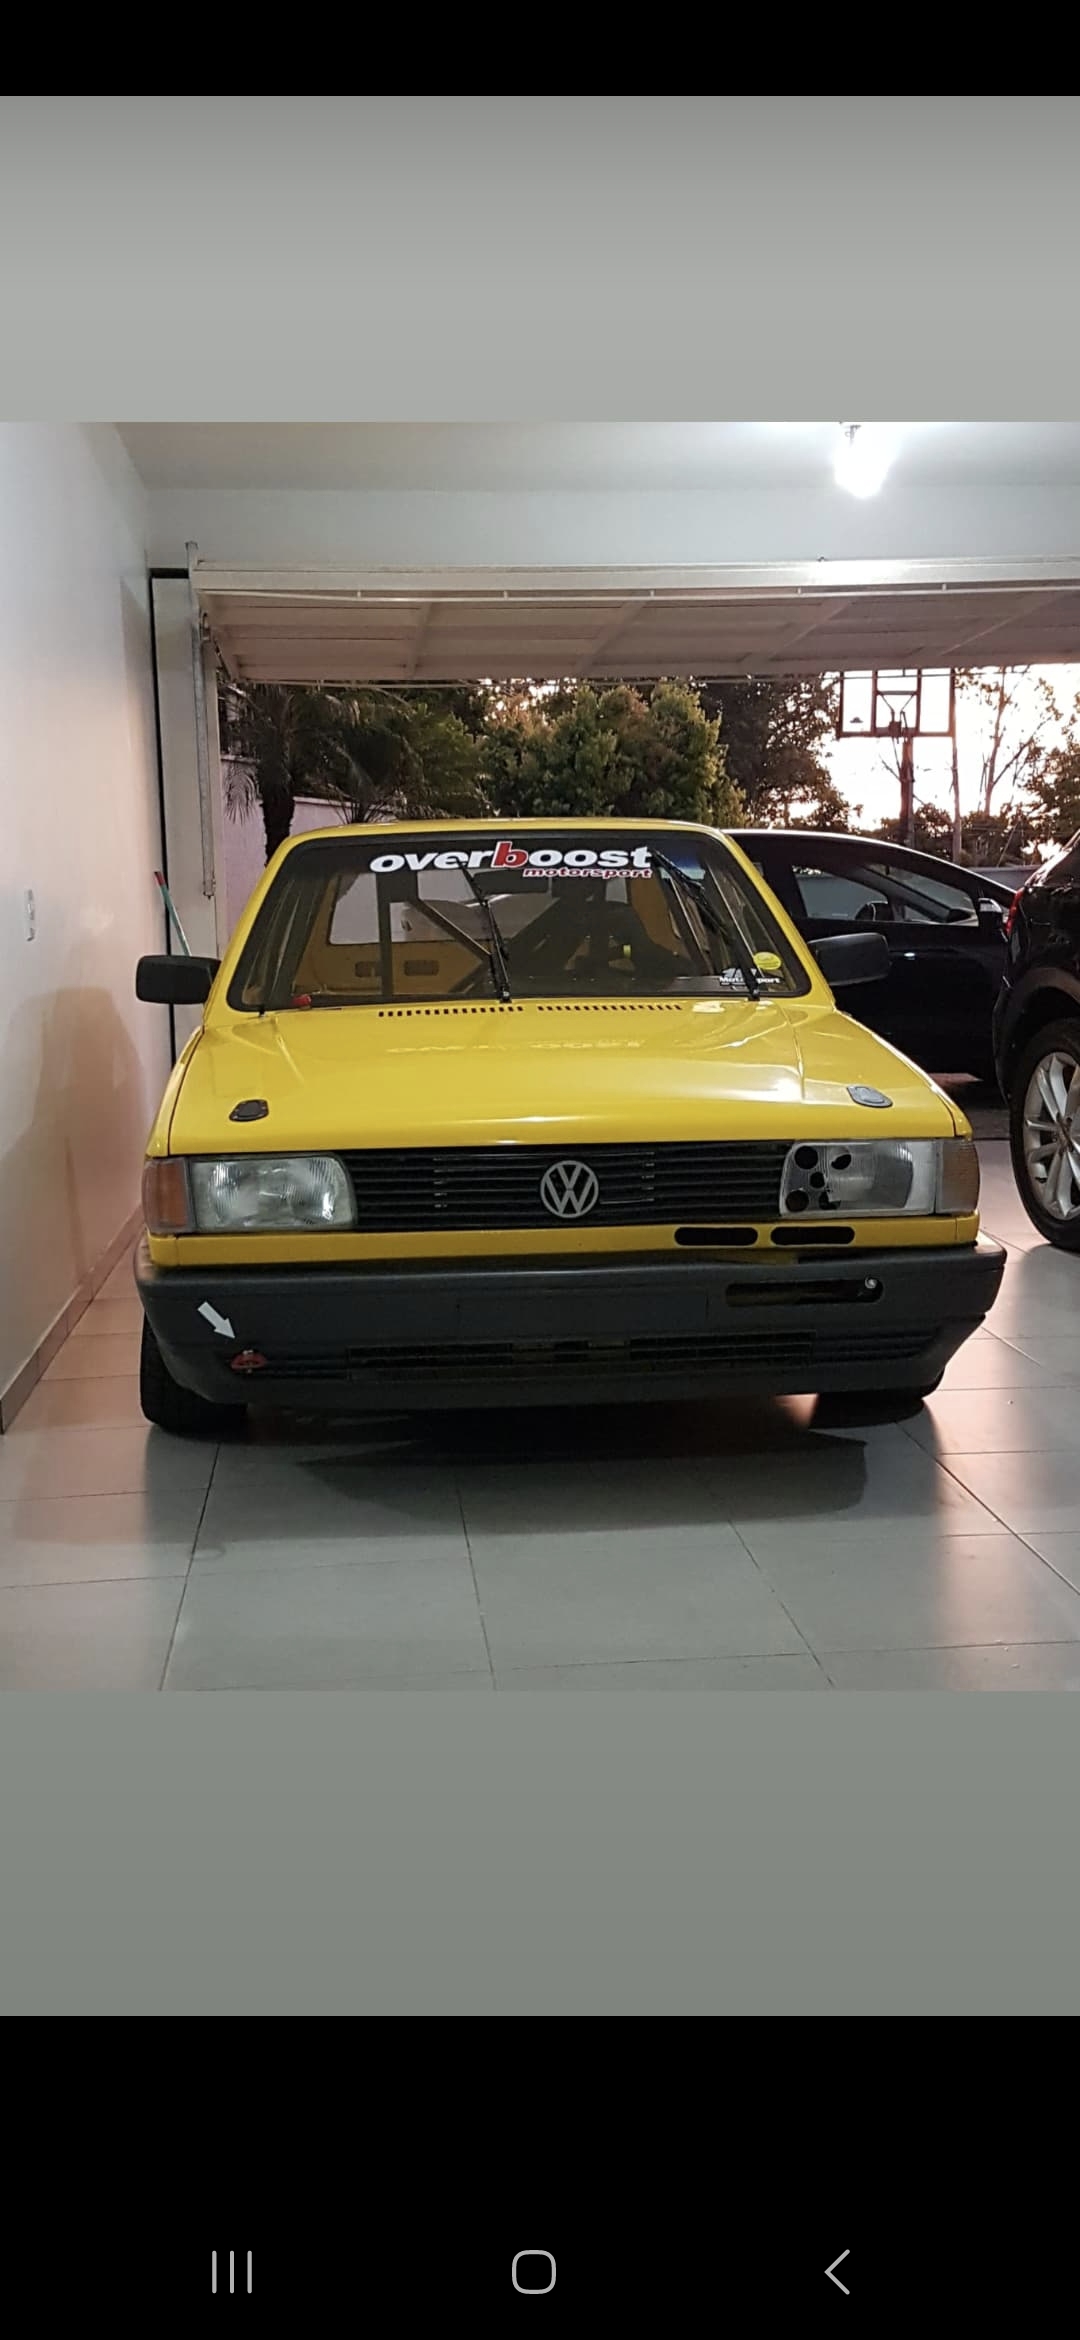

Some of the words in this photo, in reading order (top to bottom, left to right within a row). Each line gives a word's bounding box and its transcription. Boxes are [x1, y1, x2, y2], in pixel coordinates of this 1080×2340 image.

[369, 841, 652, 873] overboost
[522, 867, 653, 879] motorsport
[540, 1160, 599, 1218] VW
